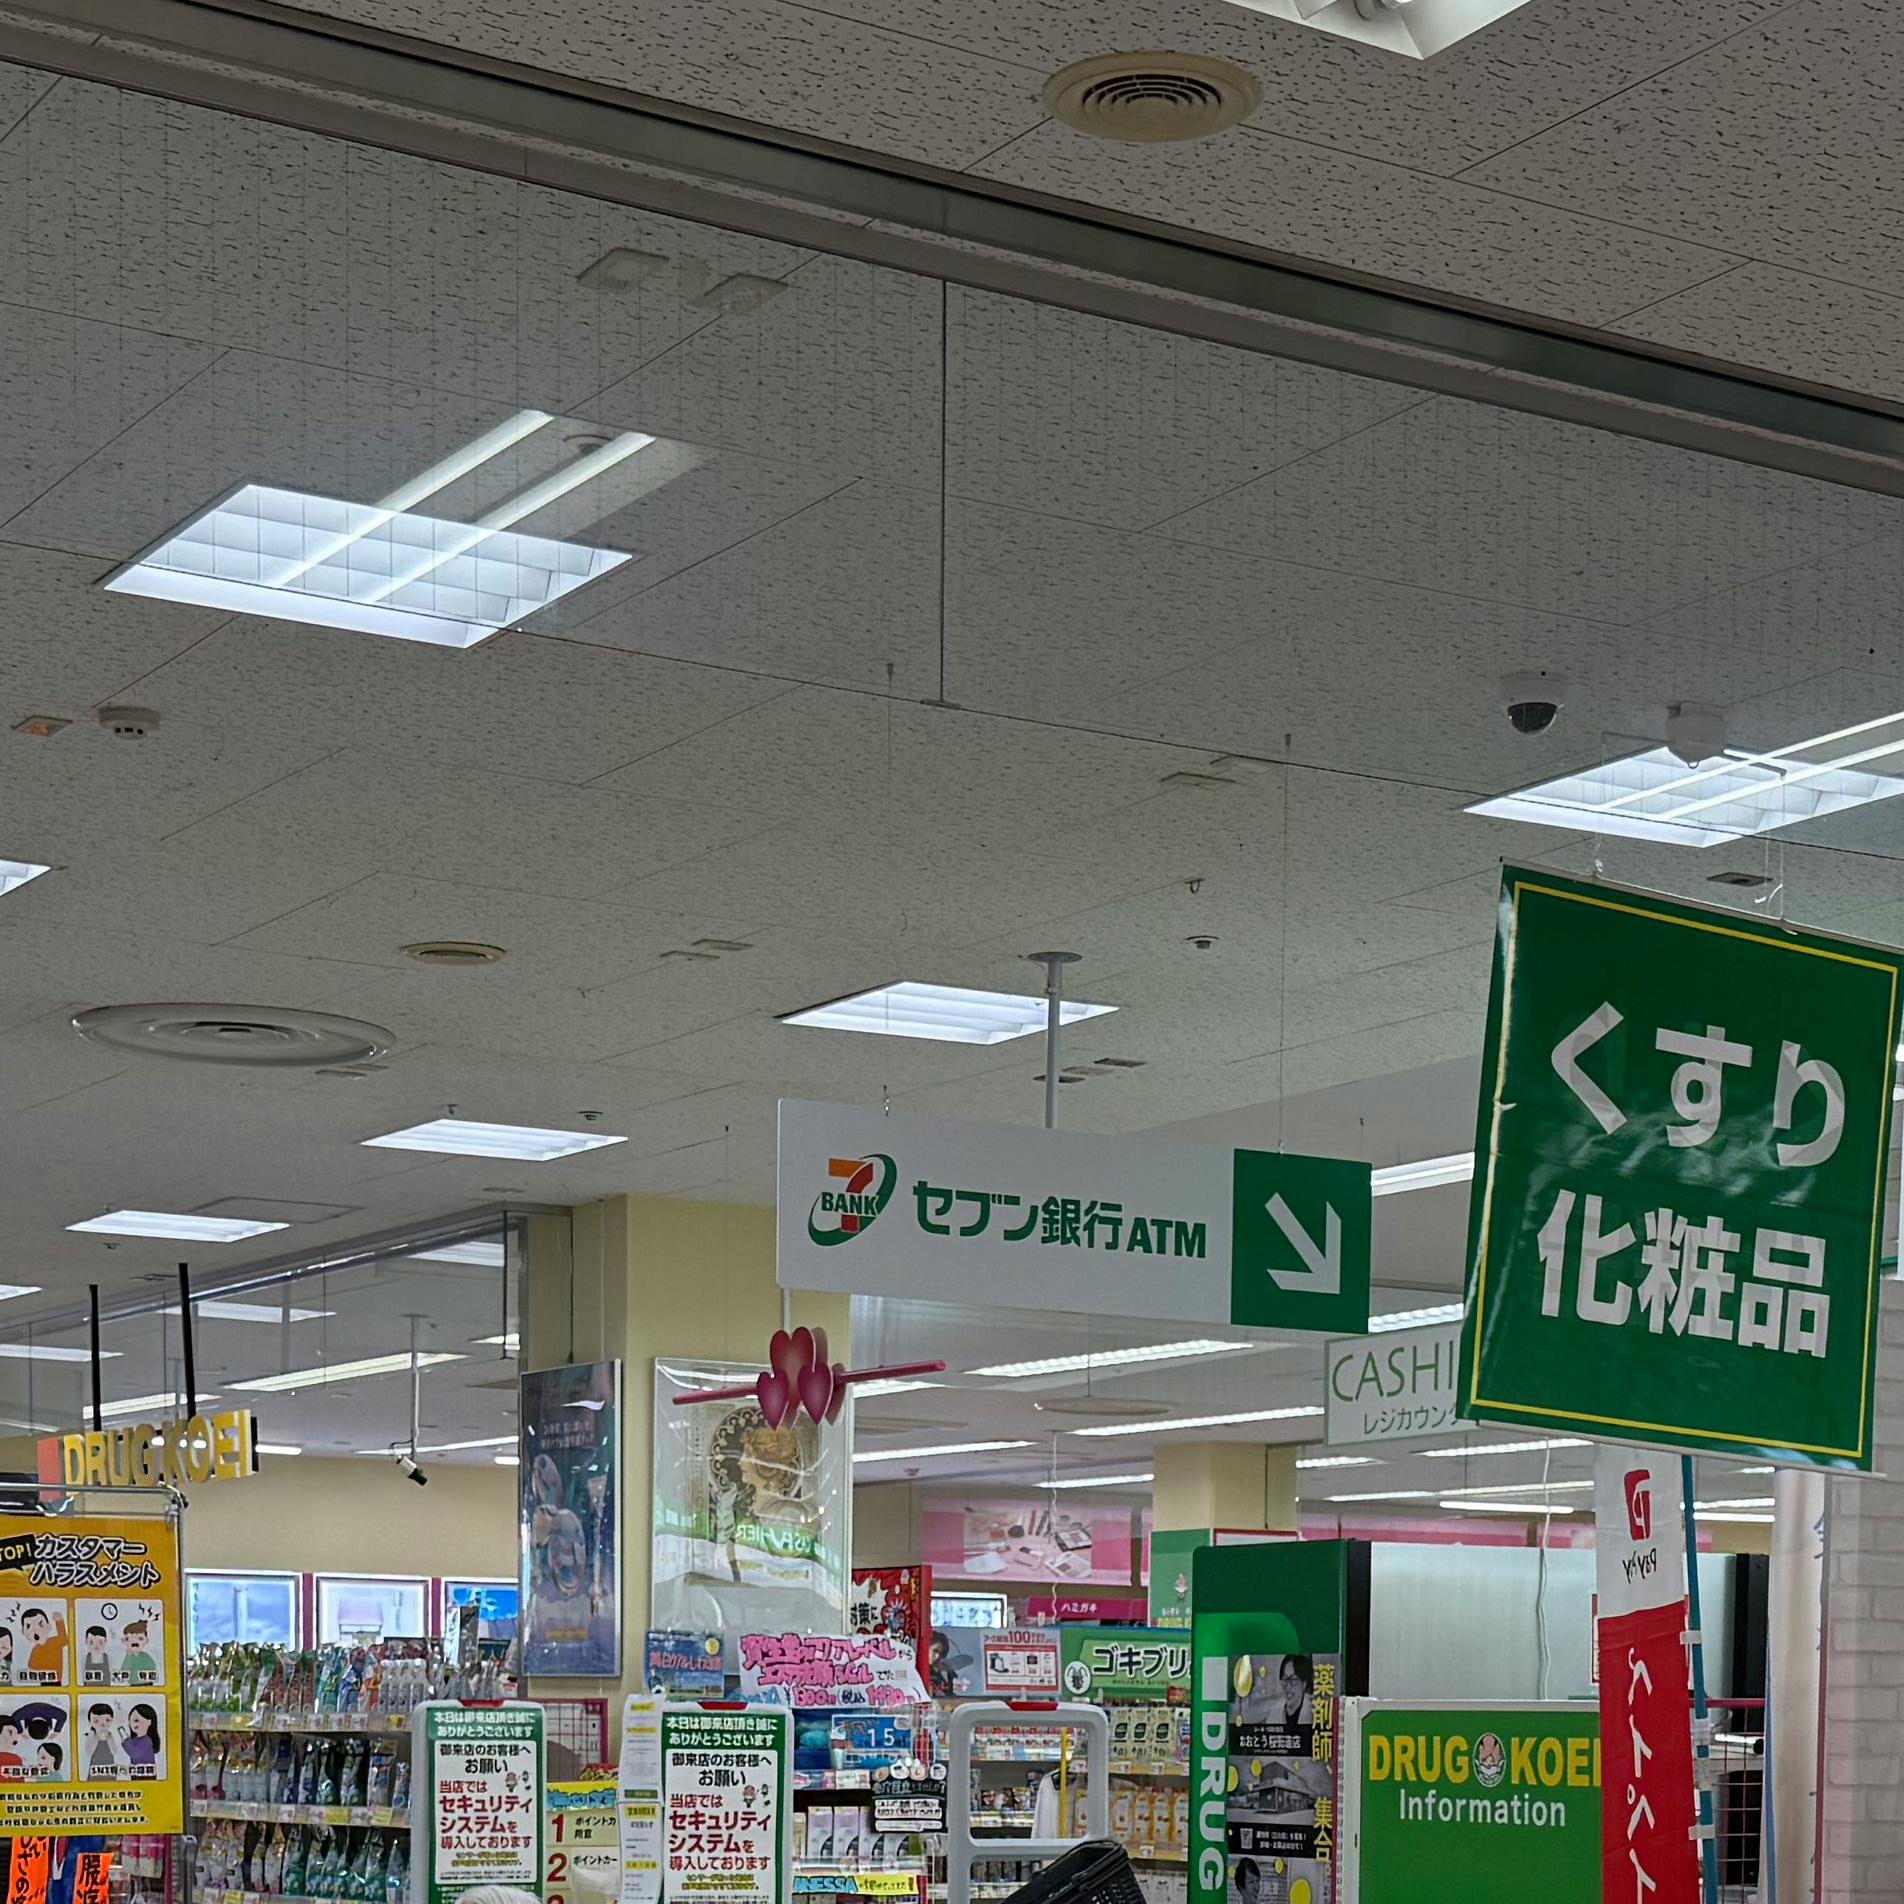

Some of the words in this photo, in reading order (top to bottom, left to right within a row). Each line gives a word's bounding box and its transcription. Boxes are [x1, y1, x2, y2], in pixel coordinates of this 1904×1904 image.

[1550, 1000, 1846, 1168] くすり
[820, 1190, 879, 1216] BANK
[912, 1179, 1207, 1260] セブン銀行ATM
[1536, 1187, 1832, 1359] 化粧品
[1332, 1340, 1454, 1403] CASHI
[62, 1423, 156, 1487] DRUG
[162, 1409, 253, 1484] KOEI
[33, 1533, 148, 1560] カスタマー
[29, 1561, 162, 1588] ハラスメント
[1060, 1602, 1098, 1614] ハミガキ
[1092, 1642, 1191, 1679] ゴキブリ
[437, 1725, 534, 1739] ありがとうございます
[669, 1732, 776, 1747] ありがとうございます
[439, 1743, 533, 1757] 御来店のお客様へ
[671, 1752, 773, 1768] 御来店のお客様へ
[1368, 1733, 1469, 1783] DRUG
[464, 1757, 509, 1775] お願い
[439, 1780, 488, 1795] 当店では
[698, 1768, 747, 1788] お願い
[438, 1795, 534, 1815] セキュリティ
[669, 1793, 724, 1810] 当店では
[1197, 1711, 1228, 1891] DRUG
[1399, 1788, 1567, 1829] Information
[439, 1816, 518, 1835] システムを
[668, 1809, 773, 1832] セキュリティ
[668, 1832, 755, 1855] システムを
[669, 1855, 771, 1872] 導入しております
